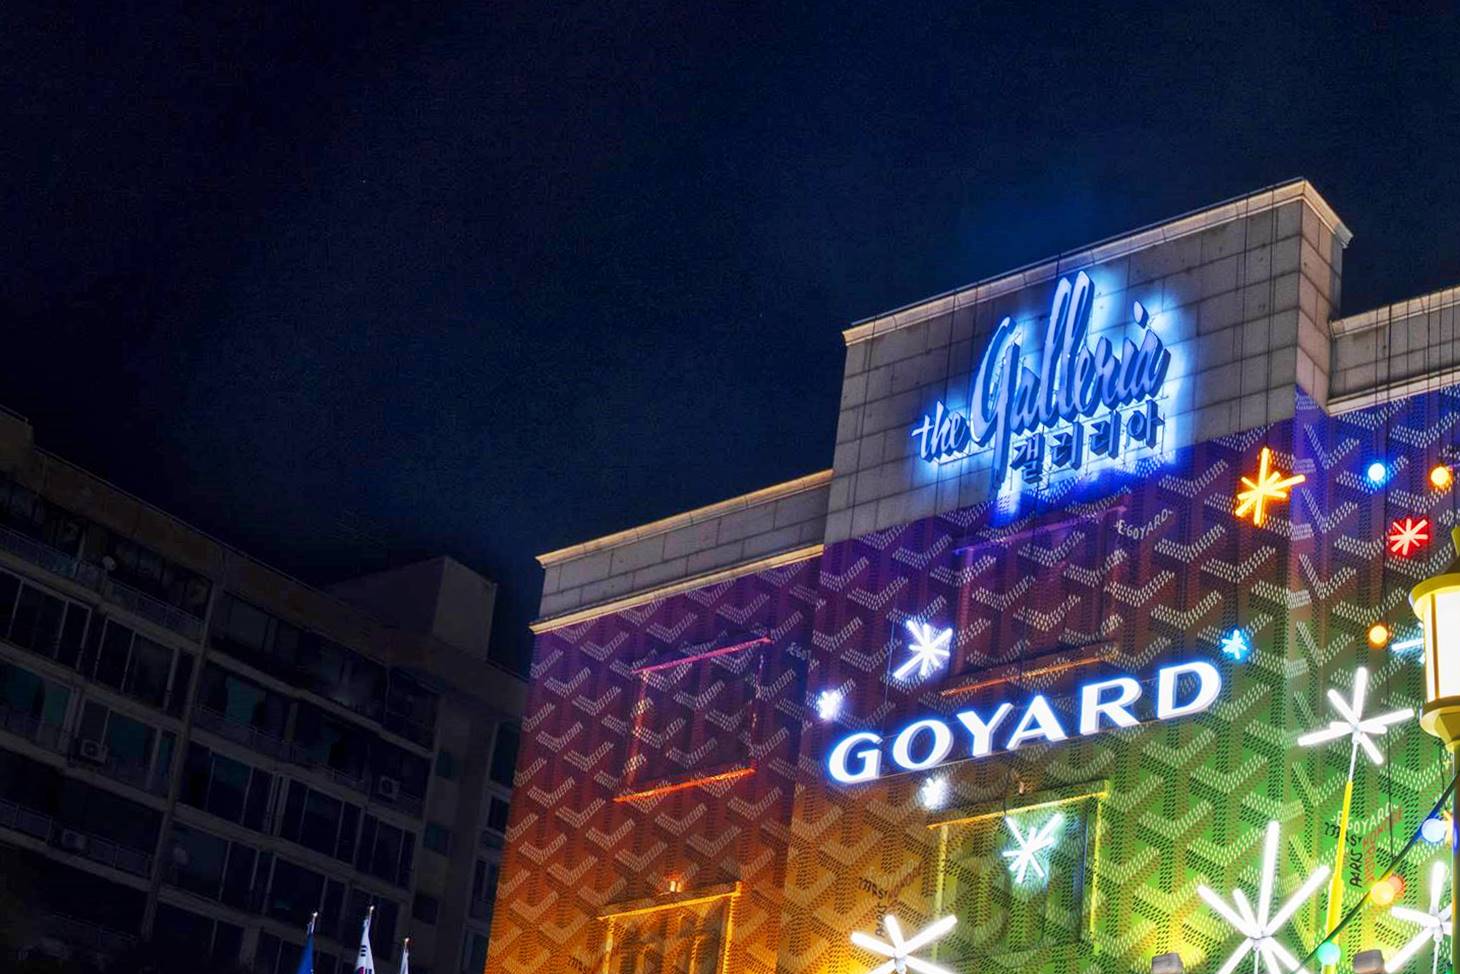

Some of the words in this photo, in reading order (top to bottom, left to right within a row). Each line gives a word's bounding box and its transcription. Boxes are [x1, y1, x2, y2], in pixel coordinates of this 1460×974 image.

[911, 400, 970, 463] the
[969, 270, 1171, 503] Galleria
[1010, 399, 1165, 484] 갤러리아
[829, 661, 1222, 783] GOYARD
